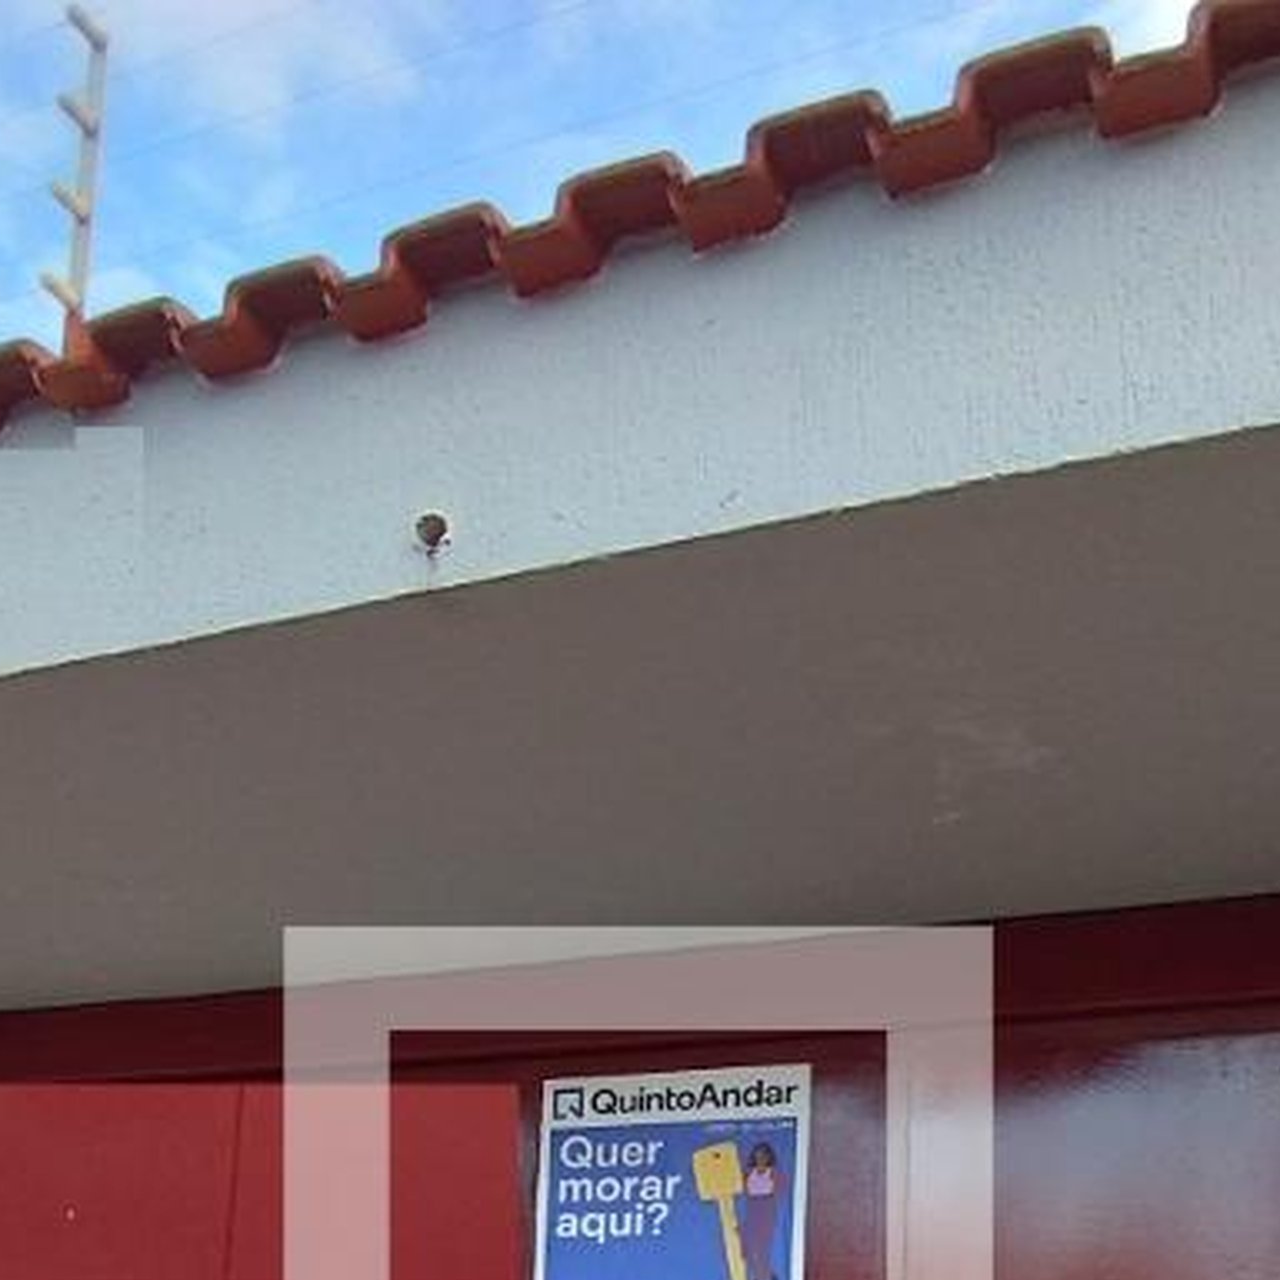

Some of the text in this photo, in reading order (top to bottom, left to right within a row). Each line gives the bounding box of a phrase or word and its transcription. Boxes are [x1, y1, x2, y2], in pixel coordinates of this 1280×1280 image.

[591, 1079, 798, 1115] QuintoAndar
[559, 1135, 664, 1169] Quer
[559, 1174, 682, 1203] morar
[555, 1202, 670, 1244] aqui?
